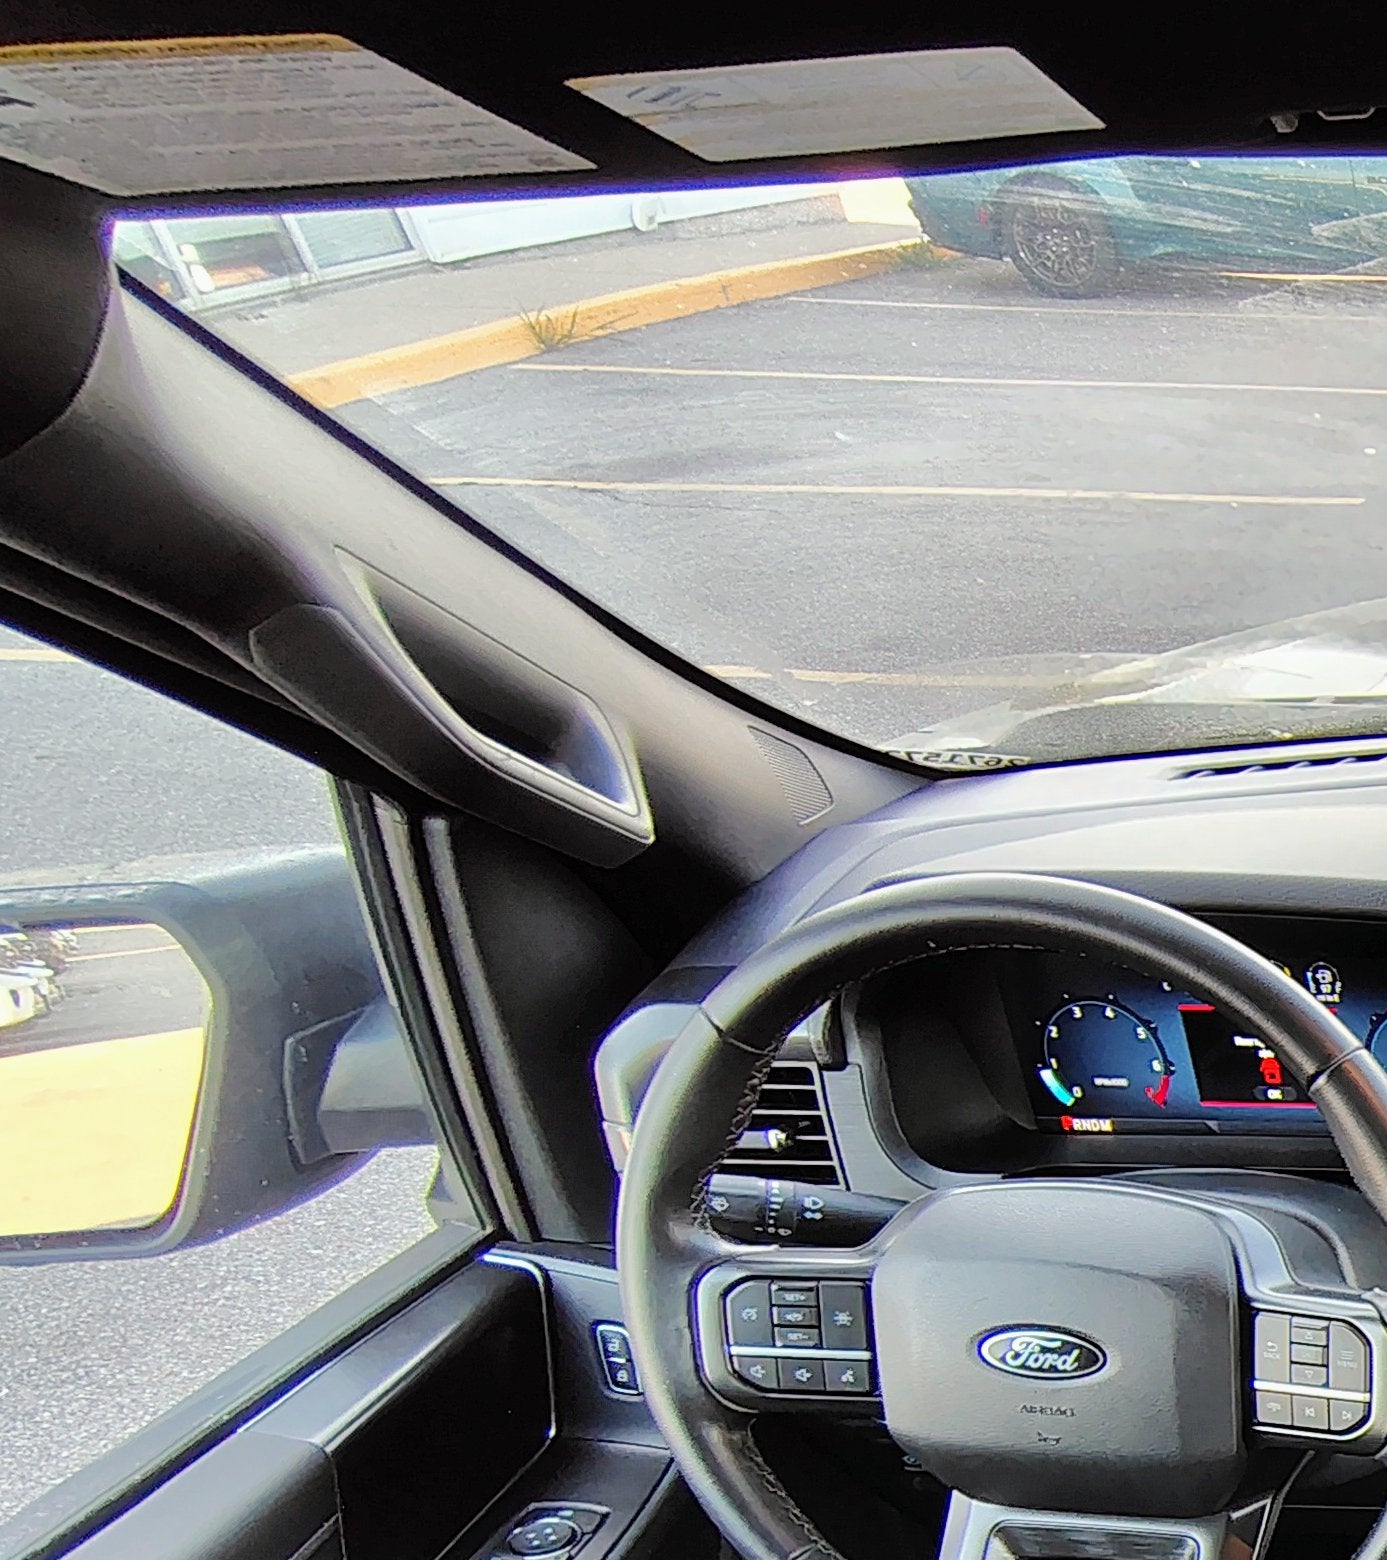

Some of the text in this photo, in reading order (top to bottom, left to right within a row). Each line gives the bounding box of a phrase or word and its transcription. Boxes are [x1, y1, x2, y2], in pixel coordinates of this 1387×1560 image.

[1072, 1006, 1082, 1019] 3
[1105, 1006, 1115, 1019] 4
[1049, 1025, 1058, 1038] 2
[1136, 1027, 1147, 1040] 5
[1050, 1058, 1058, 1070] 1
[1152, 1060, 1162, 1072] 6
[1072, 1086, 1082, 1098] 0
[1005, 1336, 1080, 1371] Ford
